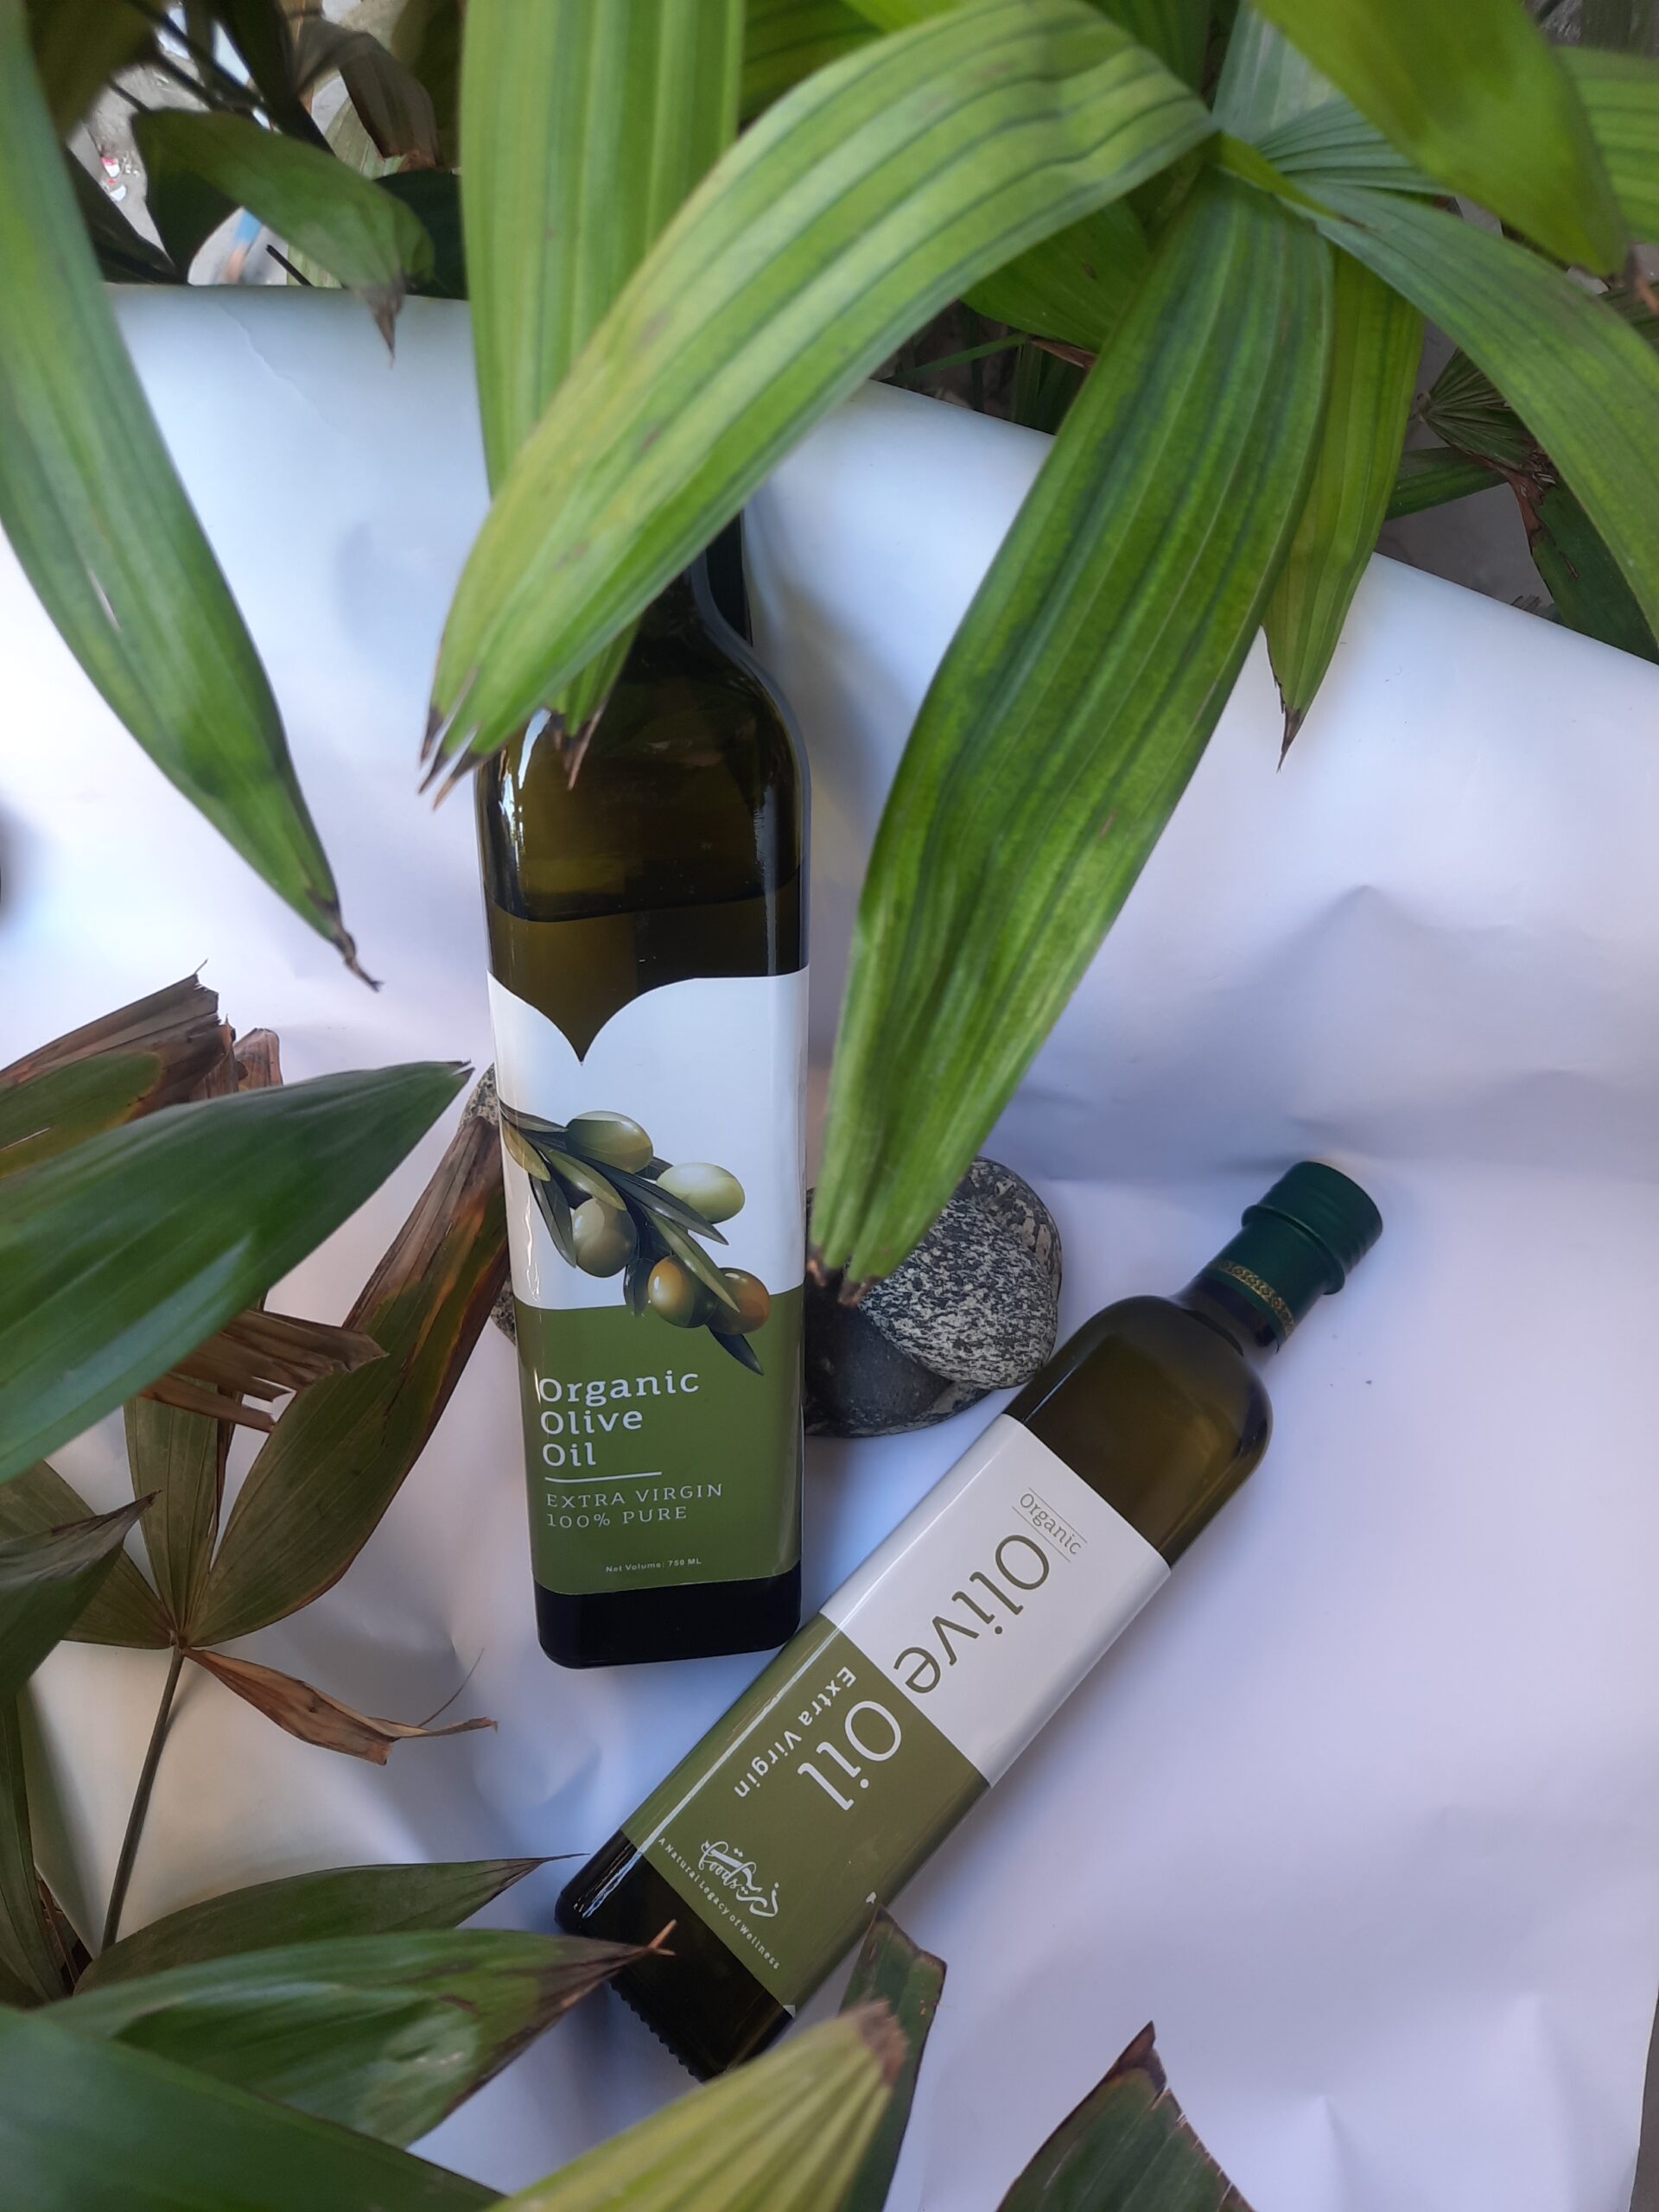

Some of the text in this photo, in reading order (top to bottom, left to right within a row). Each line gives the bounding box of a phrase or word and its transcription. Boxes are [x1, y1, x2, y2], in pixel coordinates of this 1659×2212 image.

[538, 1370, 699, 1407] Organic
[540, 1409, 643, 1435] Olive
[542, 1441, 596, 1466] Oil
[546, 1483, 722, 1509] EXTRA VIRGIN
[547, 1506, 687, 1529] 100% PURE
[1019, 1493, 1082, 1555] Organic
[668, 1559, 685, 1567] 750
[893, 1534, 1050, 1694] Olive
[734, 1666, 857, 1799] Extra Virgin
[797, 1700, 901, 1811] Oil
[658, 1837, 780, 1970] A Natural Legacy of Wellness
